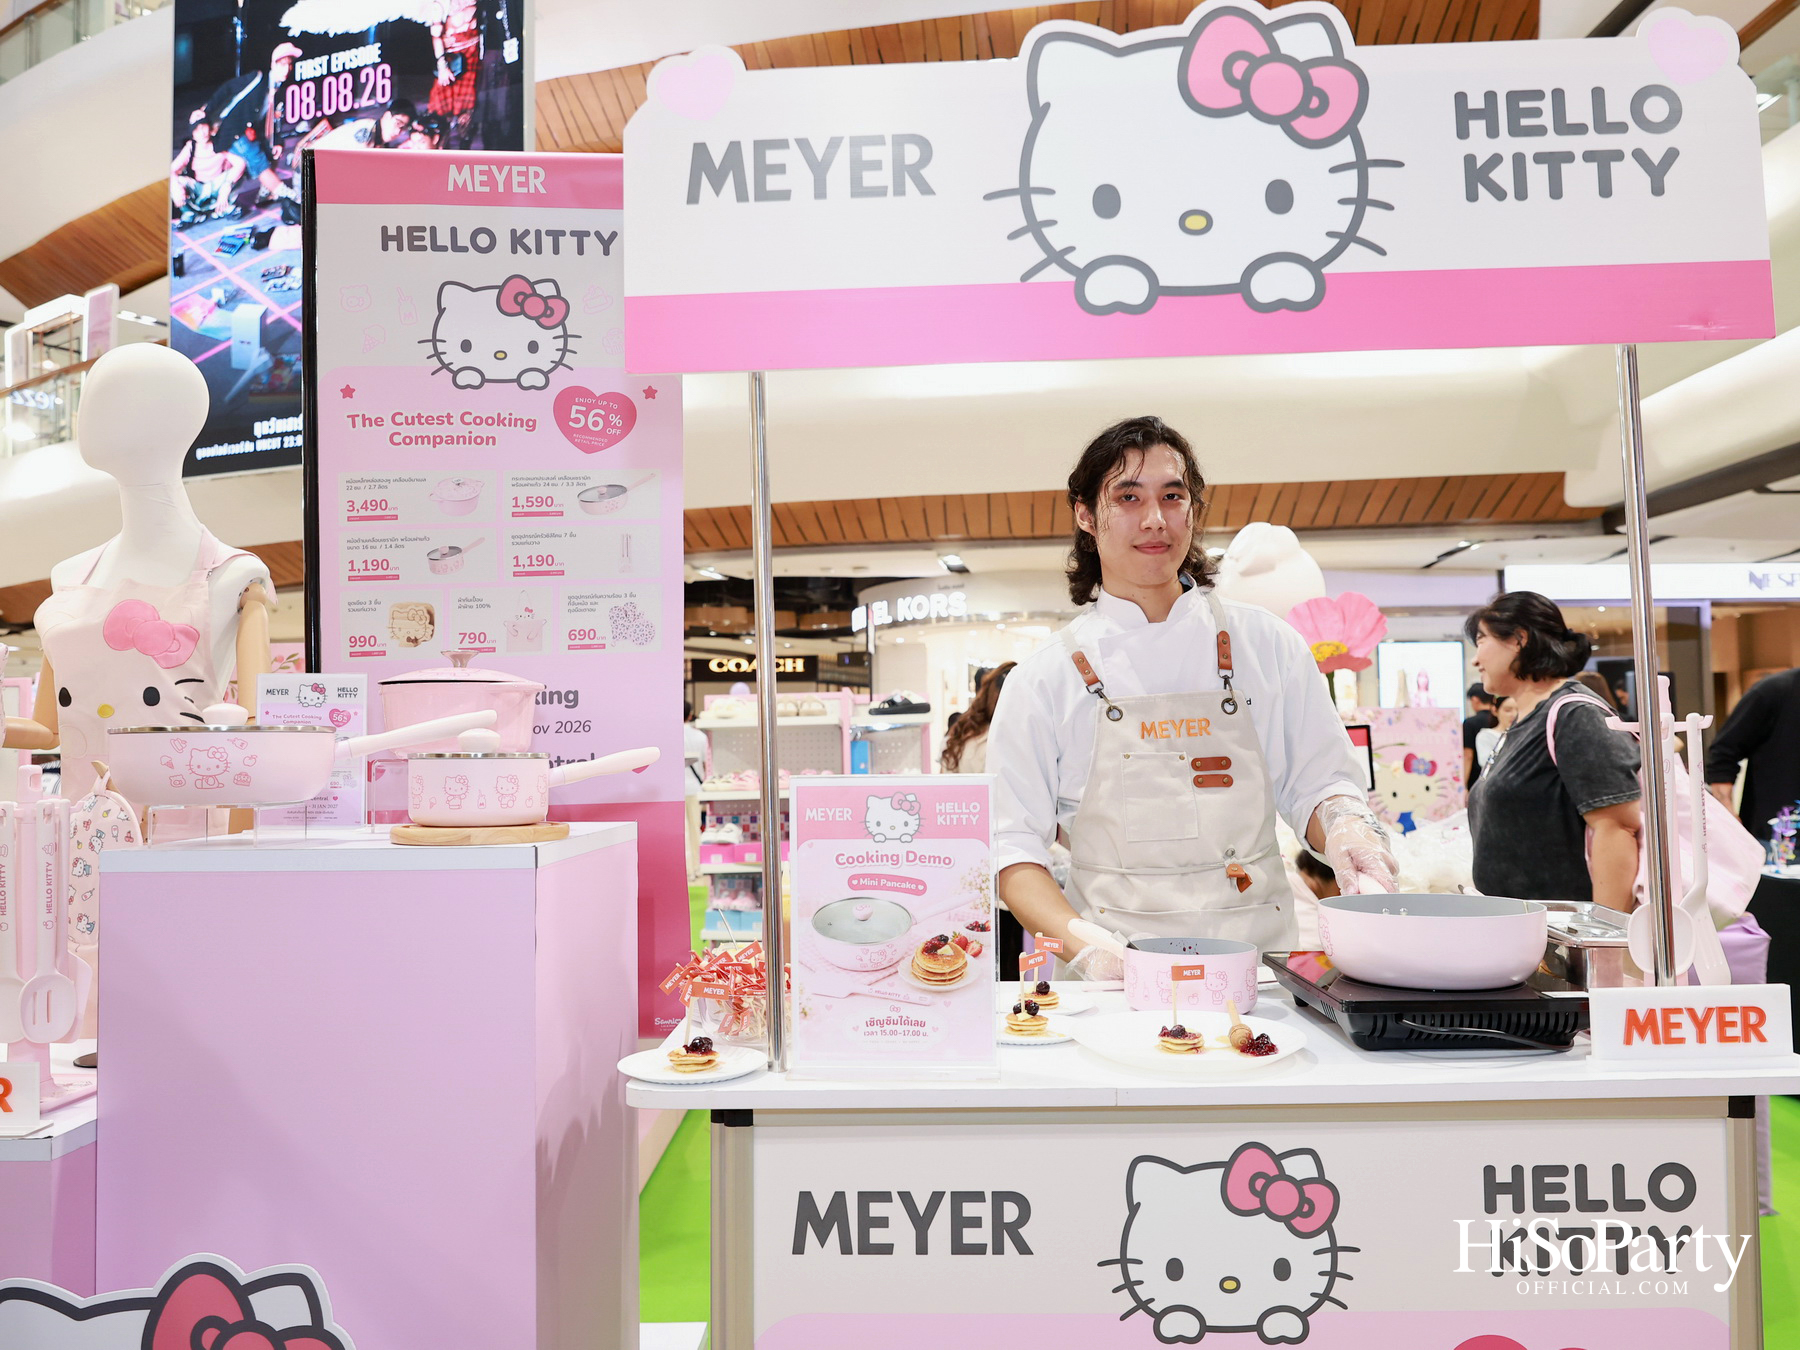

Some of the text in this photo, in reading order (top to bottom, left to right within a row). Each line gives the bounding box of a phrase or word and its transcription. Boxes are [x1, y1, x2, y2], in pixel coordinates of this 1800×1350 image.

[295, 42, 381, 82] FIRST EPISODE
[286, 63, 391, 124] 08.08.26
[1454, 84, 1682, 140] HELLO
[686, 134, 936, 205] MEYER
[1464, 147, 1680, 202] KITTY
[448, 164, 547, 193] MEYER
[381, 225, 619, 256] HELLO KITTY
[347, 412, 537, 432] The Cutest Cooking
[389, 431, 497, 448] Companion
[346, 499, 388, 514] 3,490
[512, 496, 554, 510] 1,590
[348, 559, 389, 573] 1,190
[513, 555, 554, 569] 1,190
[897, 591, 967, 622] KORS
[349, 635, 377, 648] 990
[458, 632, 486, 644] 790
[568, 629, 596, 641] 690
[555, 720, 592, 734] 2026
[1141, 718, 1211, 739] MEYER
[805, 808, 852, 821] MEYER
[936, 802, 980, 813] HELLO
[937, 814, 980, 825] KITTY
[835, 851, 952, 866] Cooking Demo
[860, 877, 916, 890] Mini Pancake
[738, 948, 754, 961] MEYER
[1028, 956, 1043, 965] MEYER
[665, 972, 681, 989] MEYER
[703, 987, 725, 995] MEYER
[866, 1016, 926, 1028] เชิญชิมได้เลย
[1623, 1006, 1768, 1046] MEYER
[1483, 1162, 1696, 1214] HELLO
[792, 1191, 1034, 1255] MEYER
[1491, 1225, 1693, 1278] KITTY
